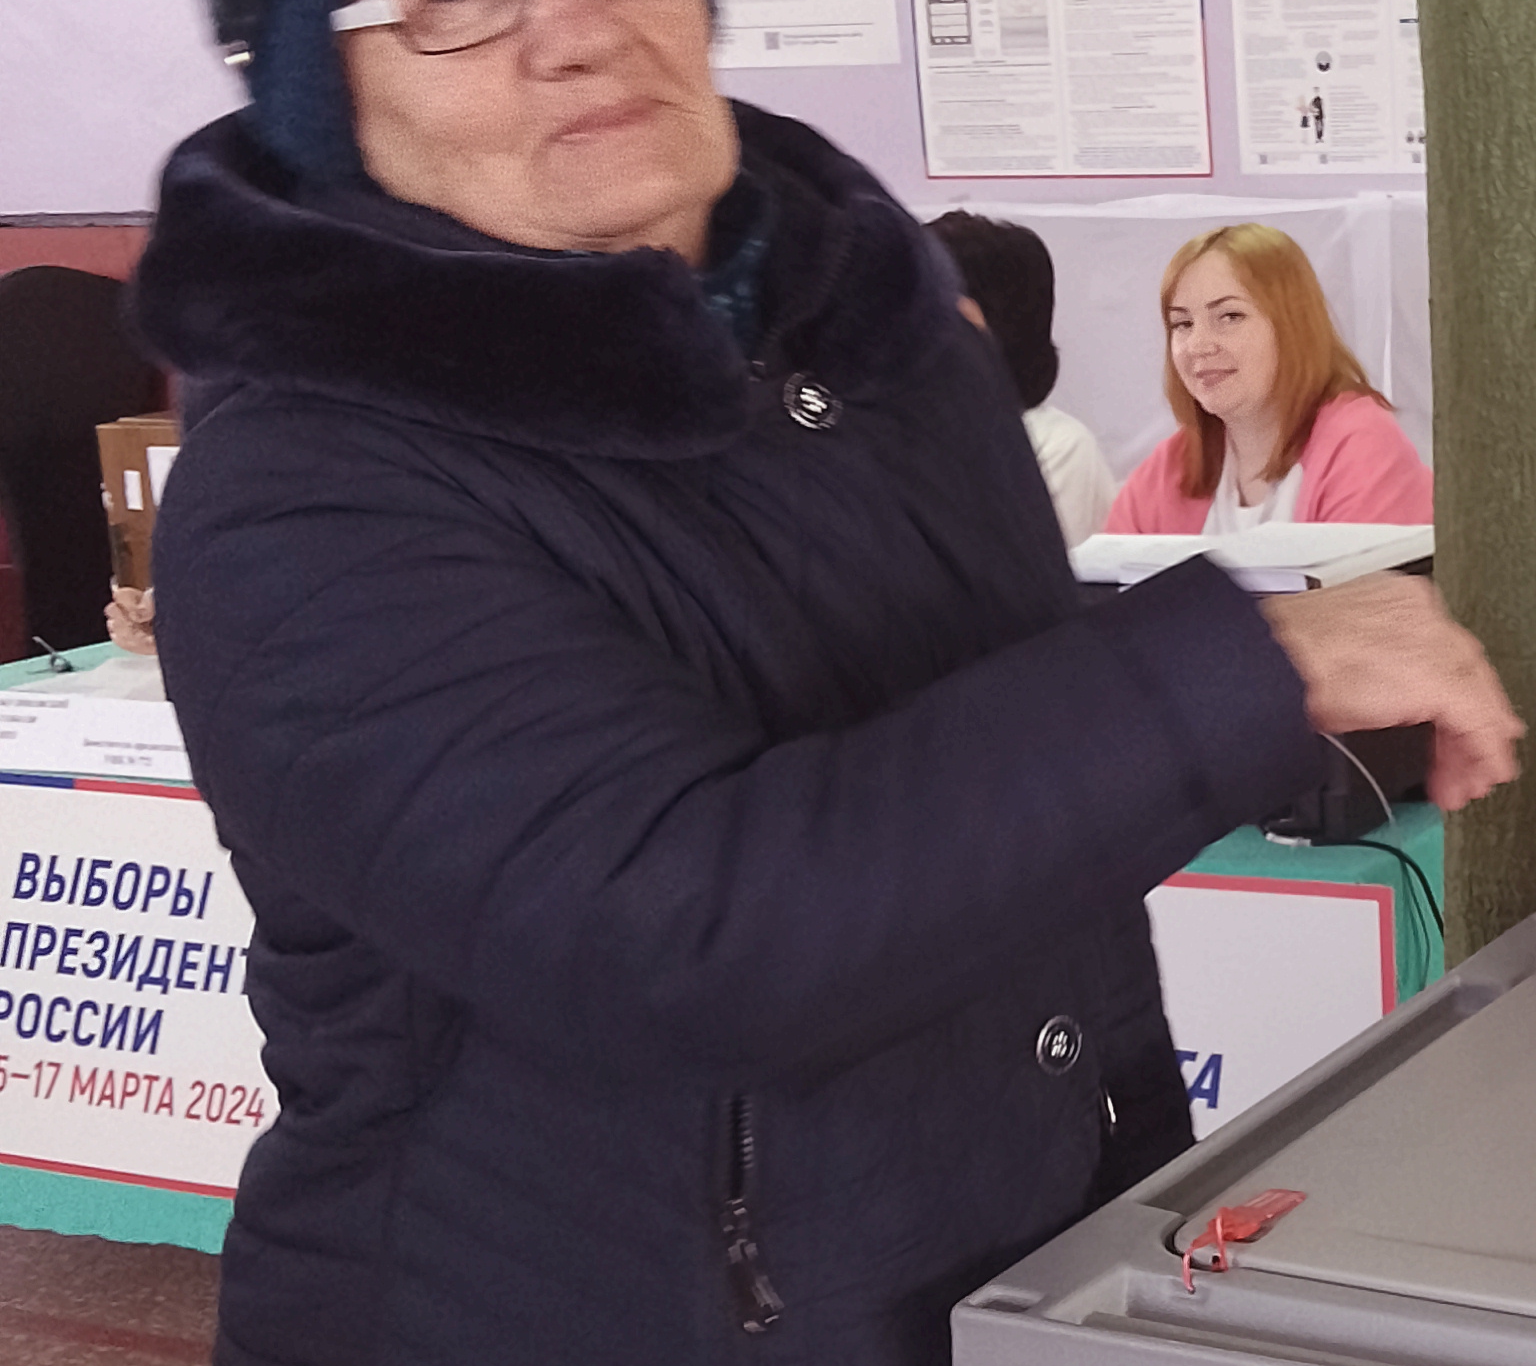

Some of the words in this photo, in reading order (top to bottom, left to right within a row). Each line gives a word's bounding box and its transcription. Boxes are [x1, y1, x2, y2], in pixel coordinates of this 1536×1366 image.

[13, 852, 213, 920] ВЫБОРЫ
[0, 921, 250, 996] ПРЕЗИДЕН
[69, 1064, 174, 1117] МАРТА
[185, 1080, 265, 1128] 2024
